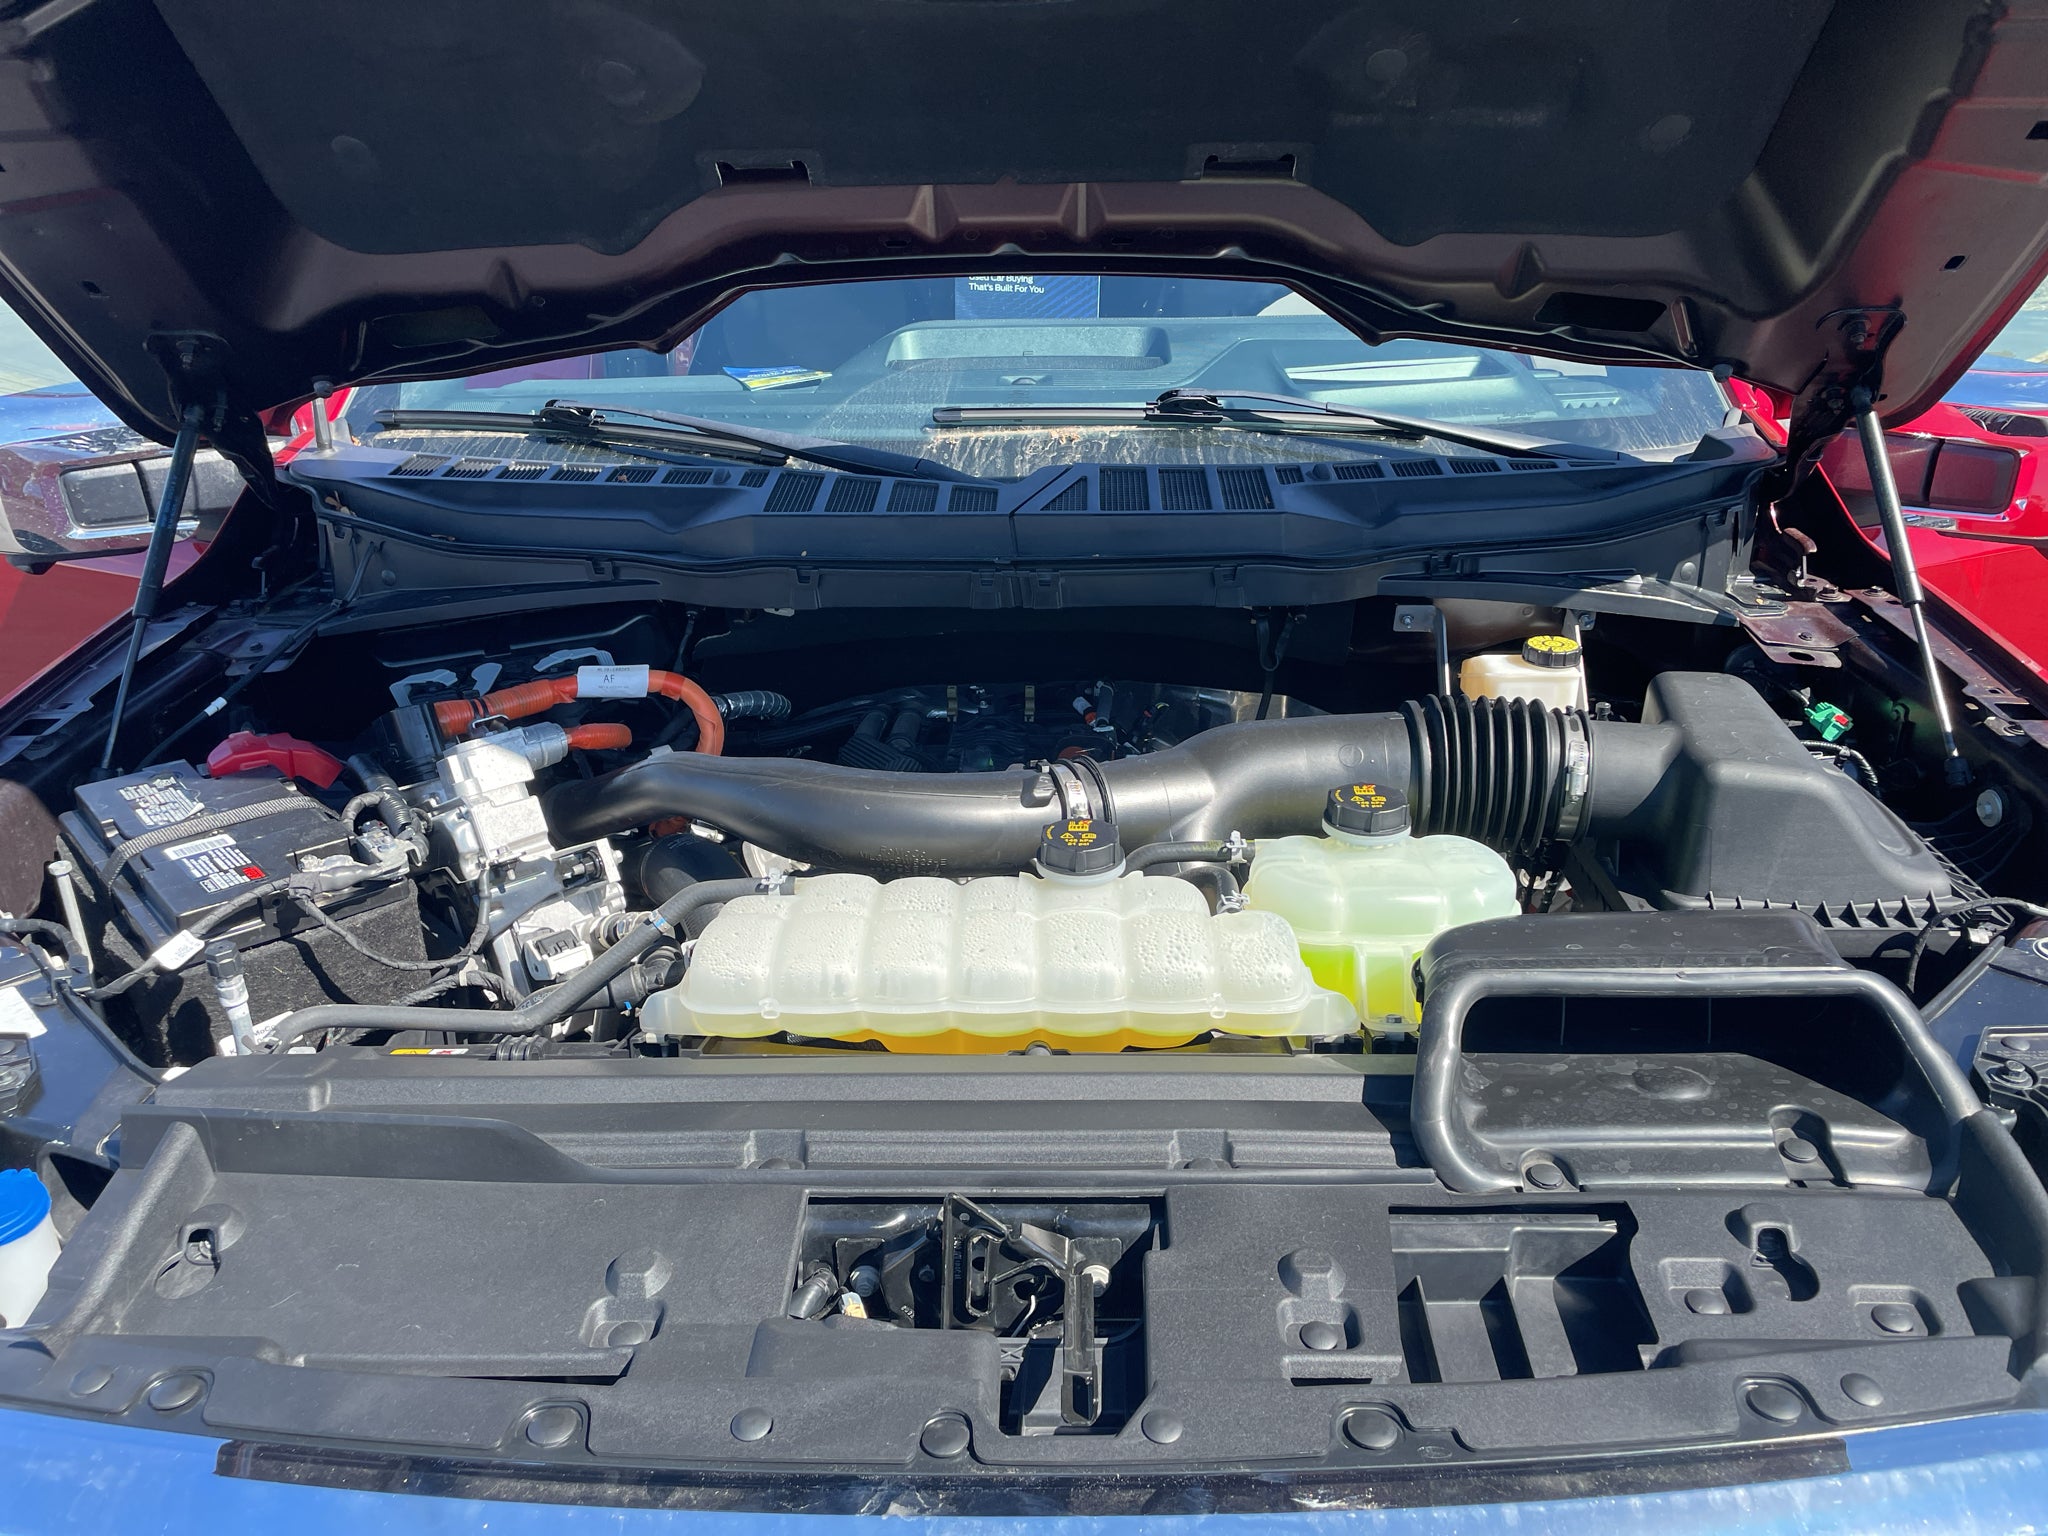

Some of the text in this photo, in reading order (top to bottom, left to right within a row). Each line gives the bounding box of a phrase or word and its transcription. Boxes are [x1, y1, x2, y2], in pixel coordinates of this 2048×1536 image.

[968, 282, 1045, 294] That's Built For You
[603, 674, 615, 684] AF
